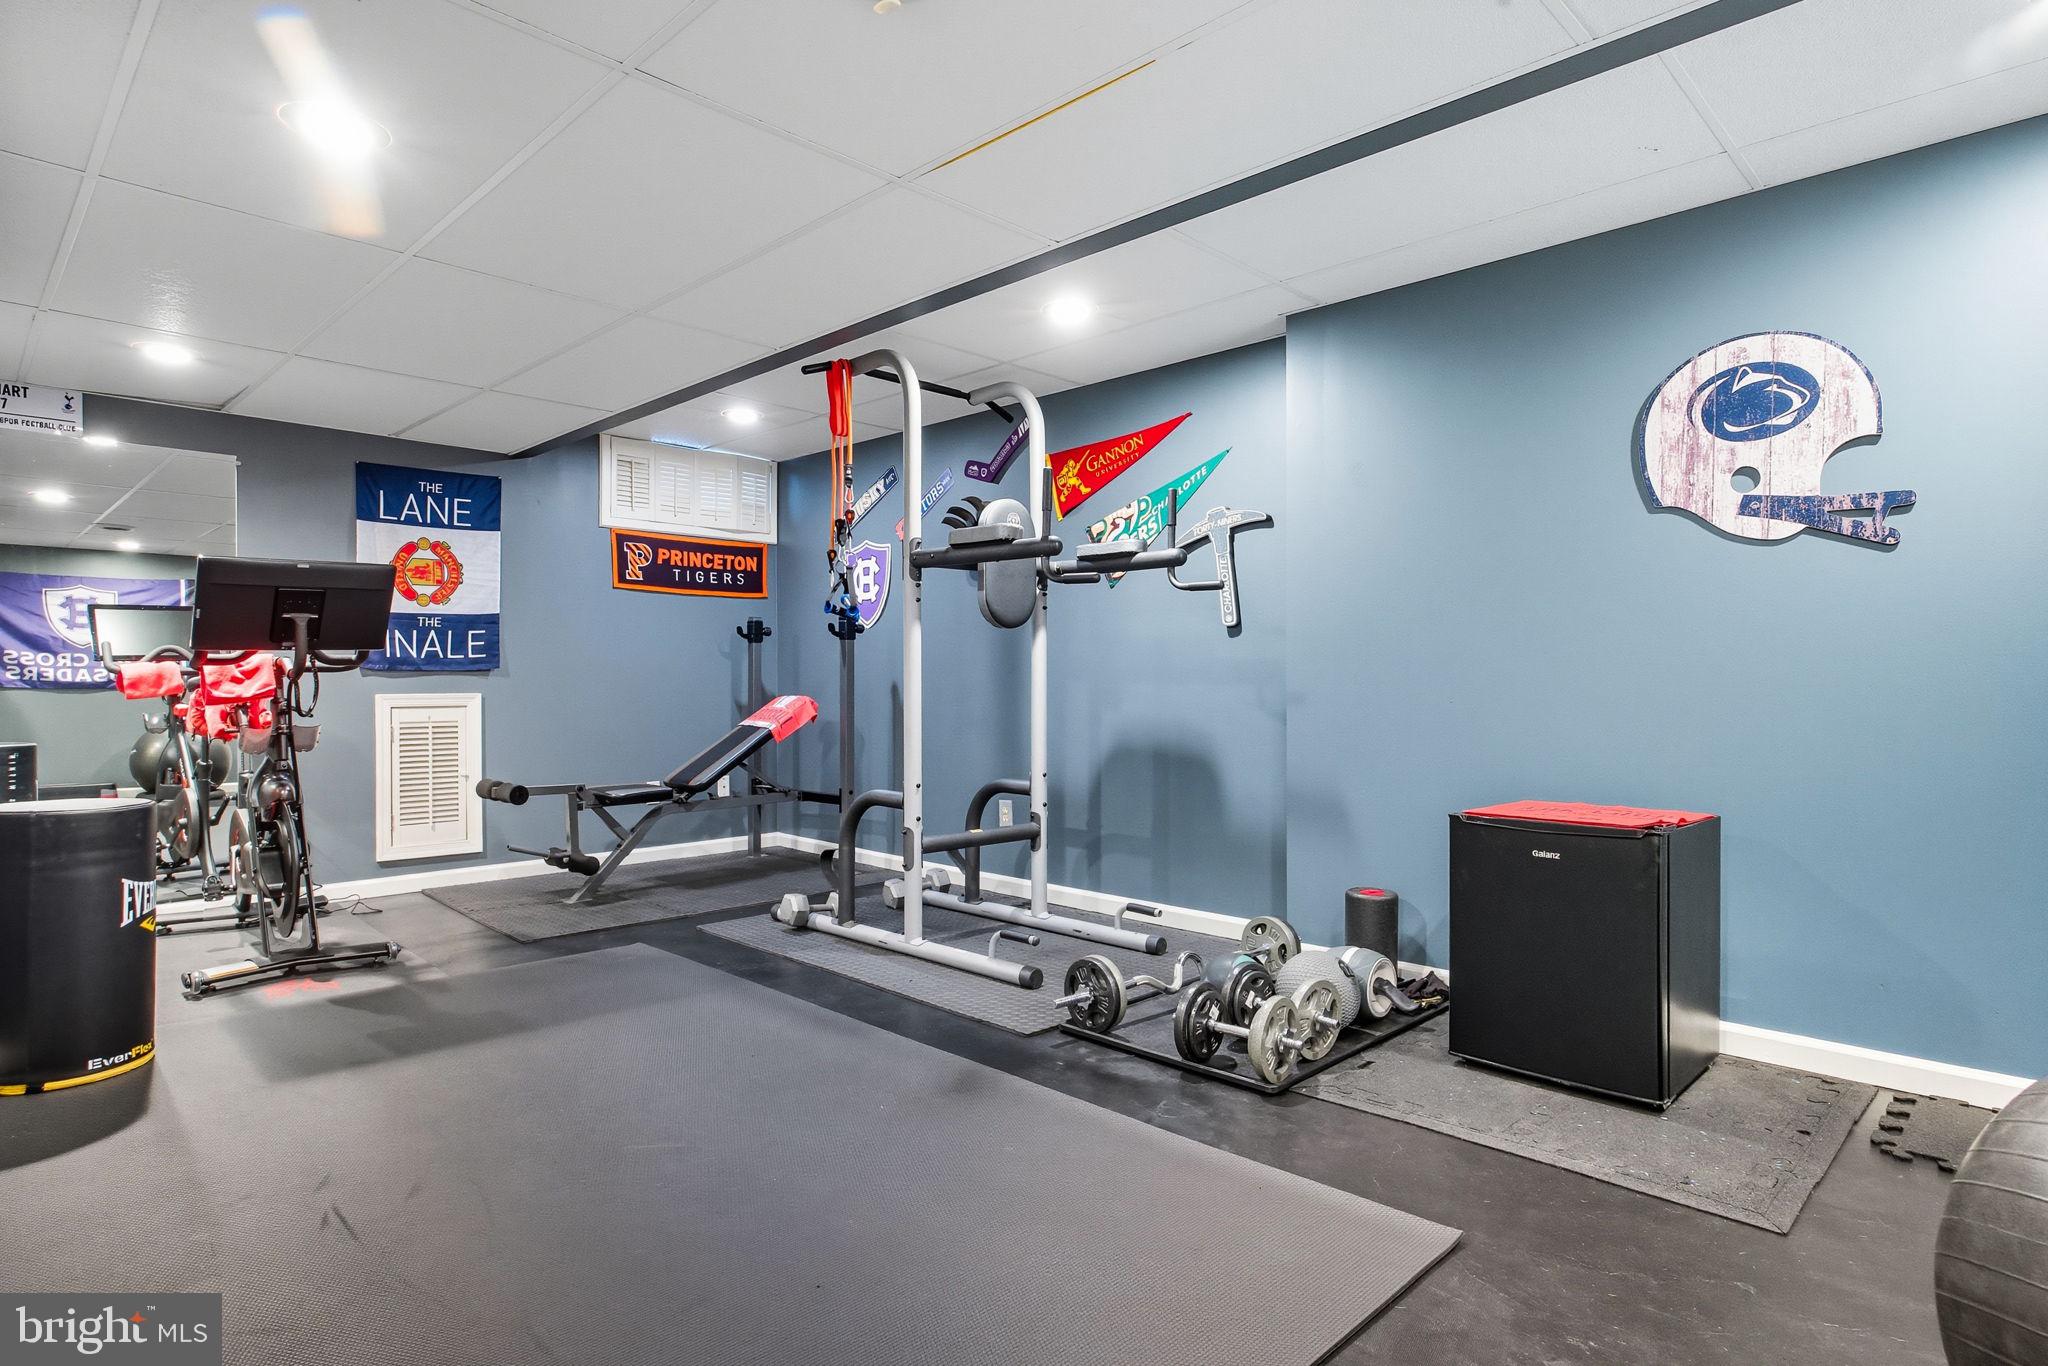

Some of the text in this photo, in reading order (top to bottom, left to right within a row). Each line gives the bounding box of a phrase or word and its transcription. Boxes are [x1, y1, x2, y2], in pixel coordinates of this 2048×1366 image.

[0, 384, 29, 398] ART
[1086, 434, 1144, 472] GANNON
[1095, 452, 1139, 477] UNIVERSITY
[418, 481, 443, 494] THE
[920, 483, 944, 516] TORS
[1152, 465, 1208, 515] CHLOTTE
[379, 490, 472, 527] LANE
[624, 541, 652, 581] P
[657, 547, 757, 573] PRINCETON
[673, 569, 745, 585] TIGERS
[417, 616, 442, 628] THE
[386, 629, 487, 659] INALE
[1532, 850, 1560, 860] Galanz
[88, 1042, 153, 1070] EverFlex
